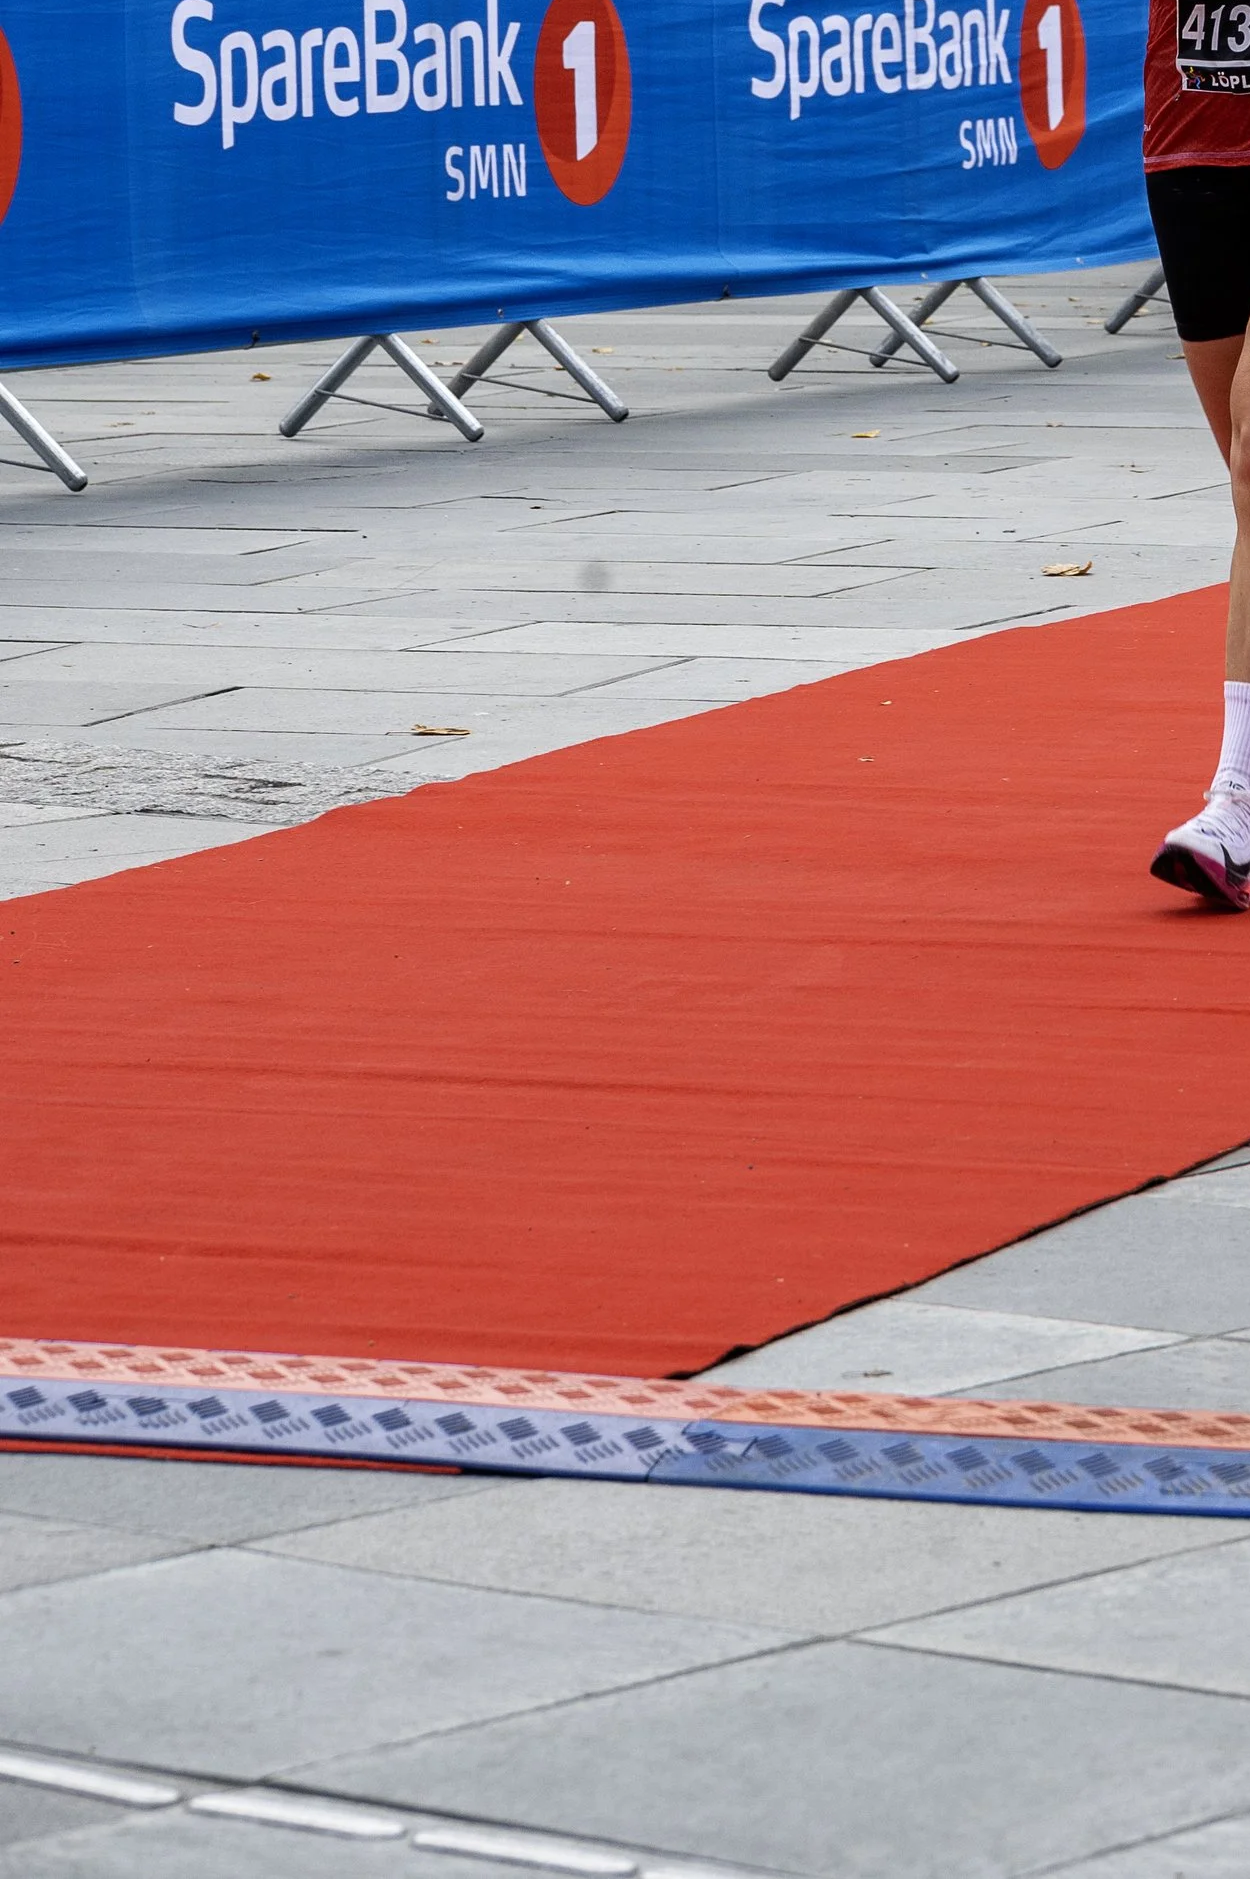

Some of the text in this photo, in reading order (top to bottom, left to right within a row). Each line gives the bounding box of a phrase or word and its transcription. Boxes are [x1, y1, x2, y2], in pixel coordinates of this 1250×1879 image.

[562, 20, 598, 162] 1
[1037, 4, 1065, 131] 1
[445, 143, 527, 202] SMN
[959, 116, 1018, 171] SMN
